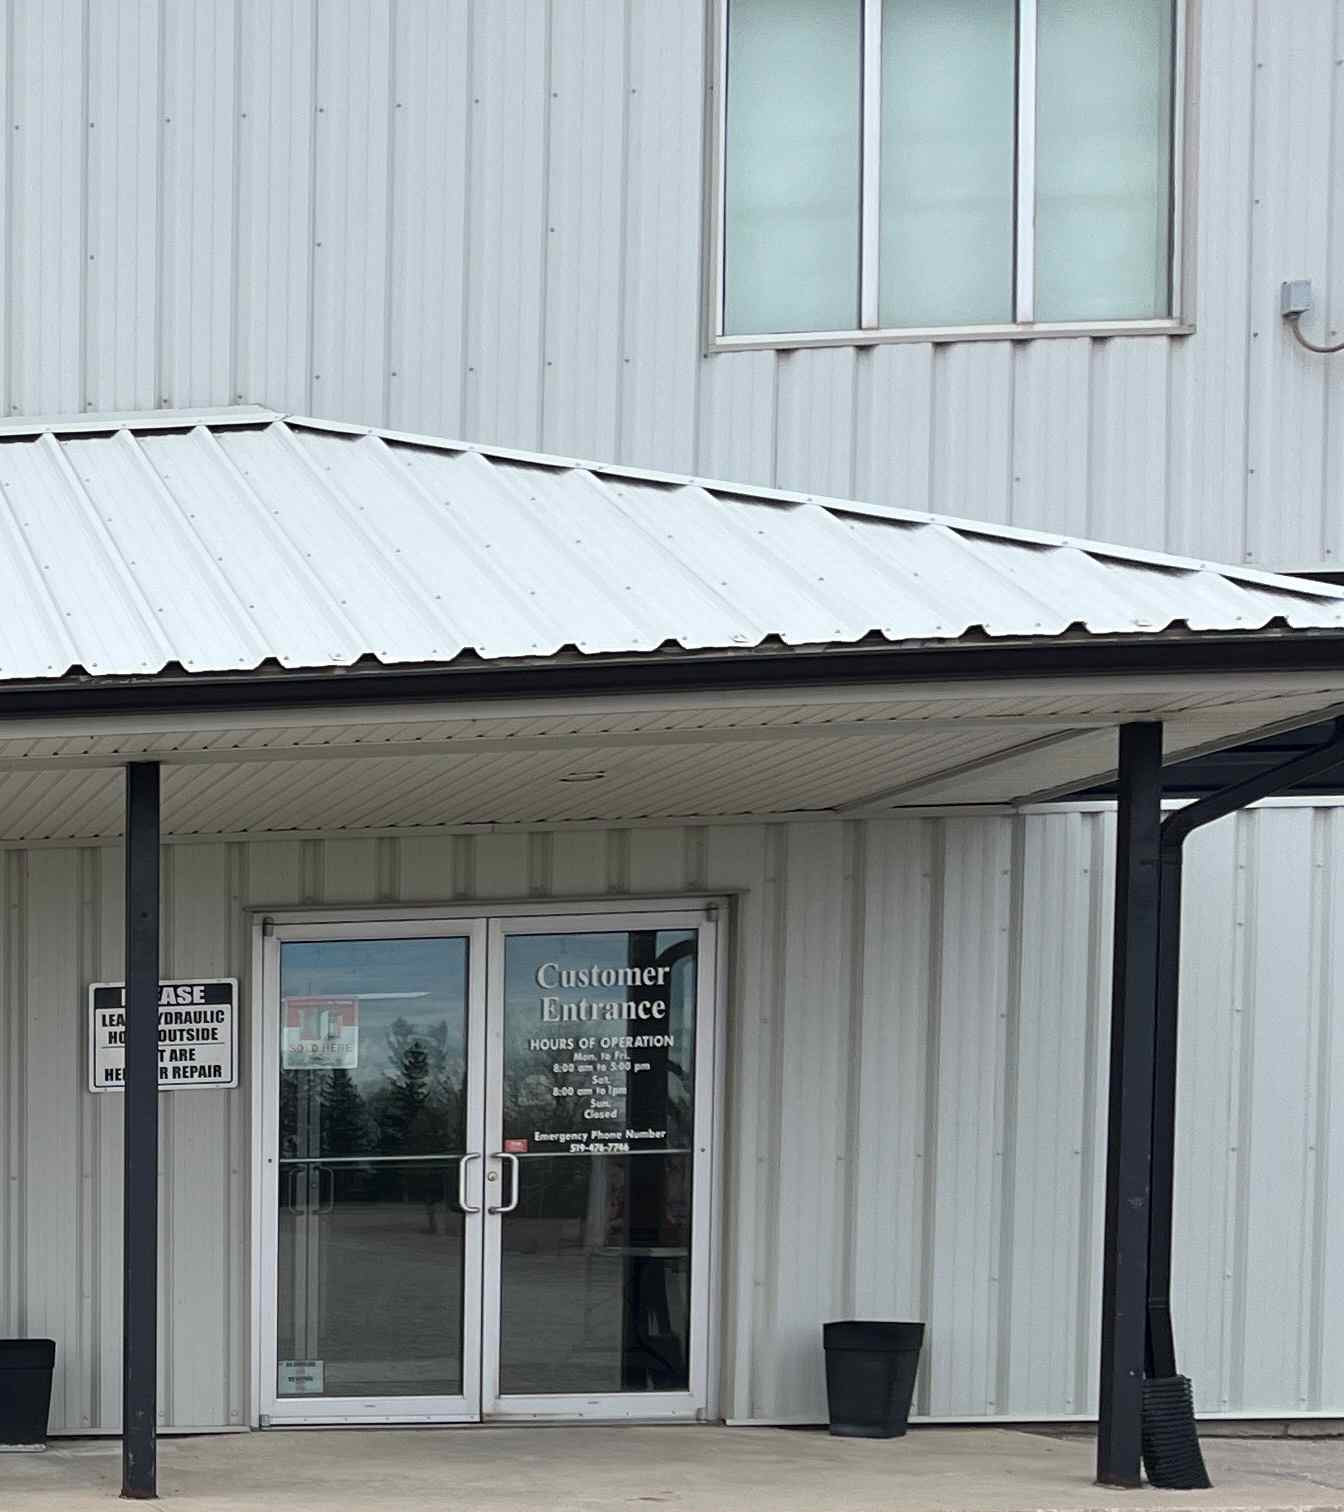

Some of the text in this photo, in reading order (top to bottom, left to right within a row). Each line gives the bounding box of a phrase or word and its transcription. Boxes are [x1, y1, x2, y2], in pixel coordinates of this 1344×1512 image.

[536, 961, 671, 989] Customer
[540, 996, 666, 1022] Entrance
[530, 1035, 674, 1050] HOURS OF OPERATION
[169, 1048, 196, 1062] ARE
[172, 1065, 222, 1079] REPAIR
[552, 1063, 575, 1073] 8:00
[597, 1063, 607, 1072] to
[634, 1063, 651, 1073] pm
[552, 1086, 575, 1097] 8:00
[583, 1108, 618, 1119] Closed
[534, 1128, 667, 1142] Emergency Phone Number
